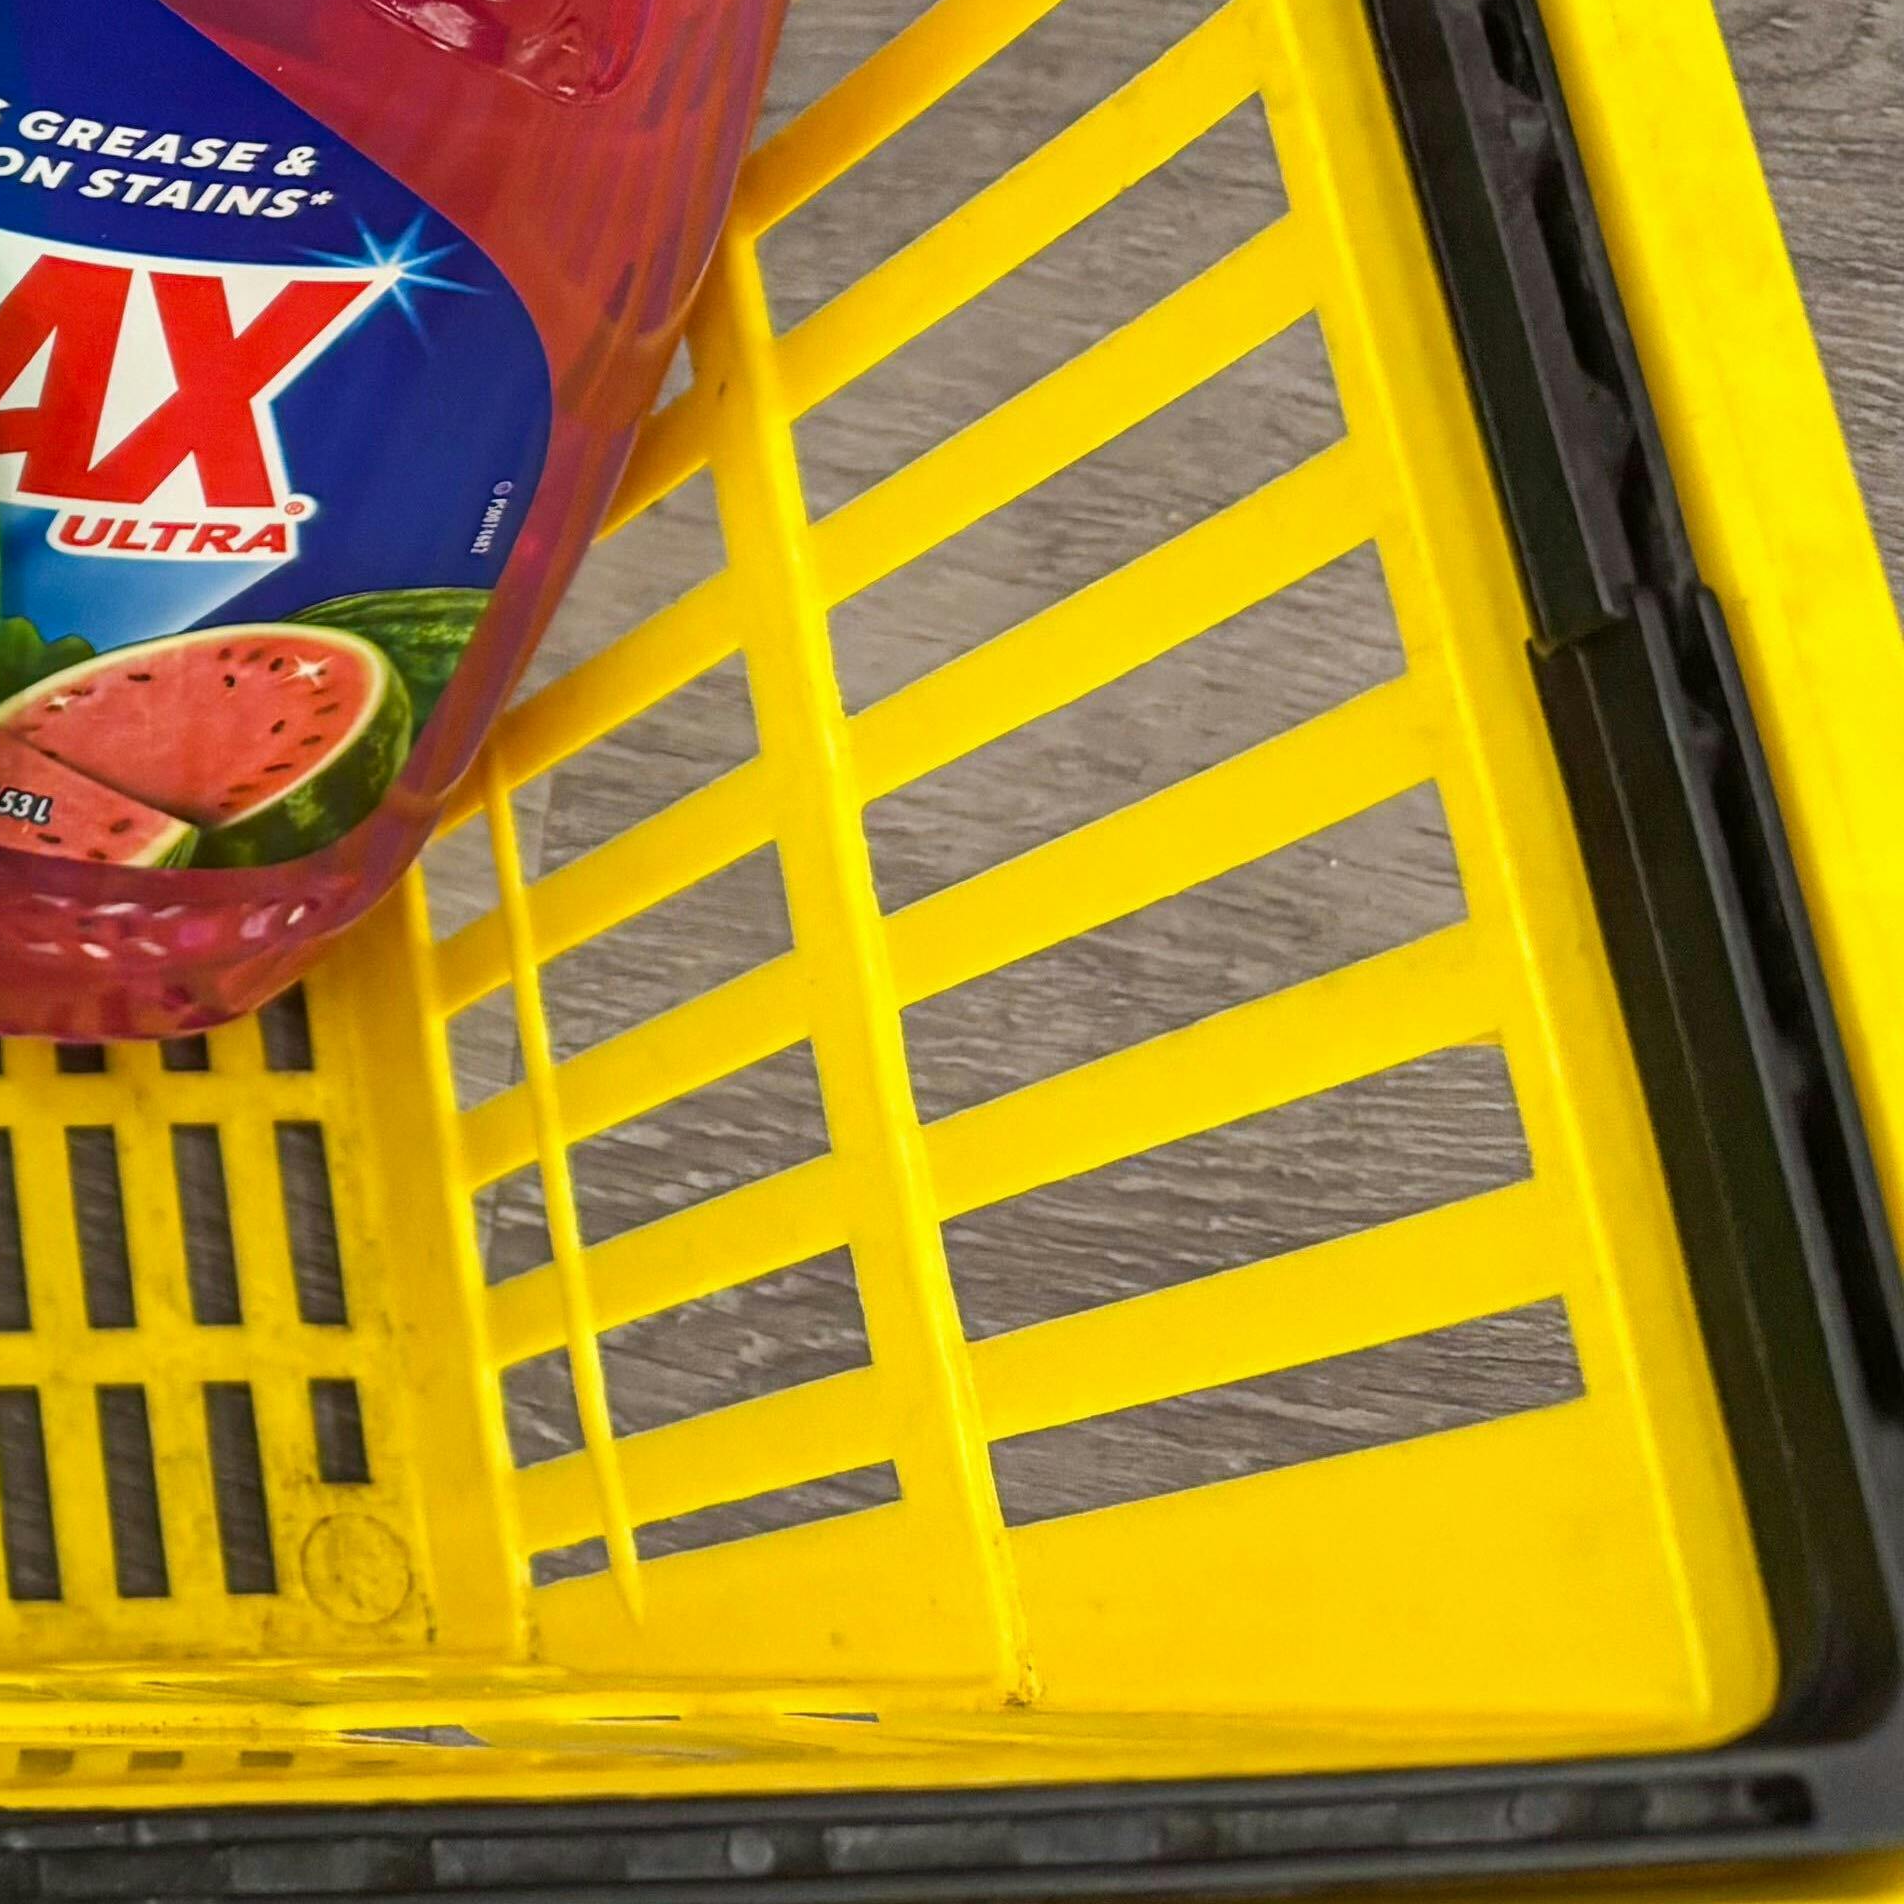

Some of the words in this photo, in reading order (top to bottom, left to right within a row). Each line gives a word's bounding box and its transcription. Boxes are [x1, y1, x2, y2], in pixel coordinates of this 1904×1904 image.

[19, 109, 268, 173] GREASE
[273, 144, 318, 178] &
[35, 794, 53, 824] L
